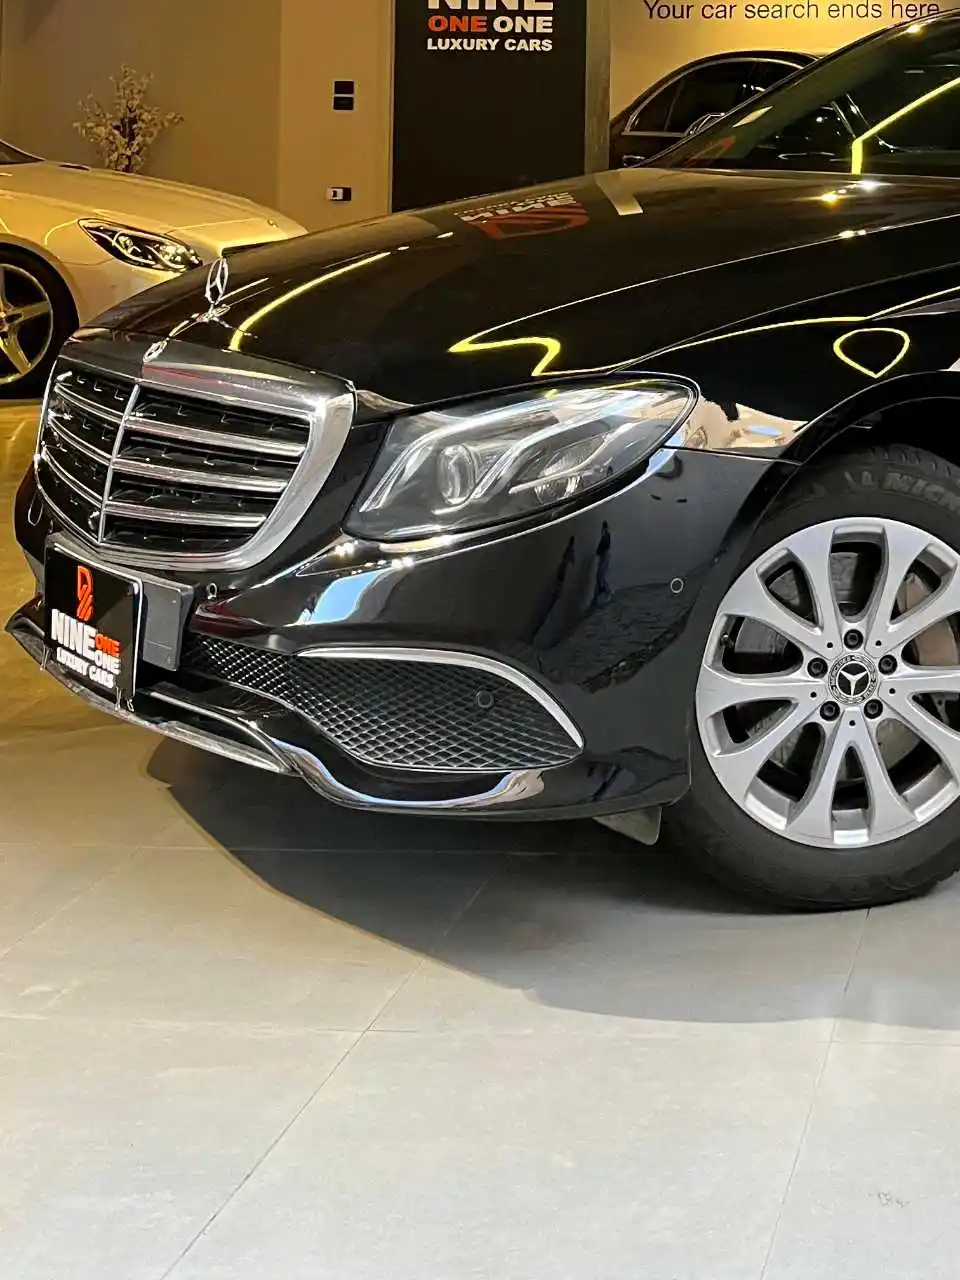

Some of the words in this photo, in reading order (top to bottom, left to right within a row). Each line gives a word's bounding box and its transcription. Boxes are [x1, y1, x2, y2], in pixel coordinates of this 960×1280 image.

[643, 0, 695, 20] Your
[701, 3, 738, 20] car
[744, 0, 820, 20] search
[827, 0, 883, 20] ends
[427, 15, 488, 33] ONE
[492, 15, 554, 34] ONE
[426, 37, 501, 51] LUXURY
[504, 38, 554, 52] CARS
[51, 608, 98, 661] NINE
[94, 633, 121, 658] ONE
[94, 649, 122, 675] ONE
